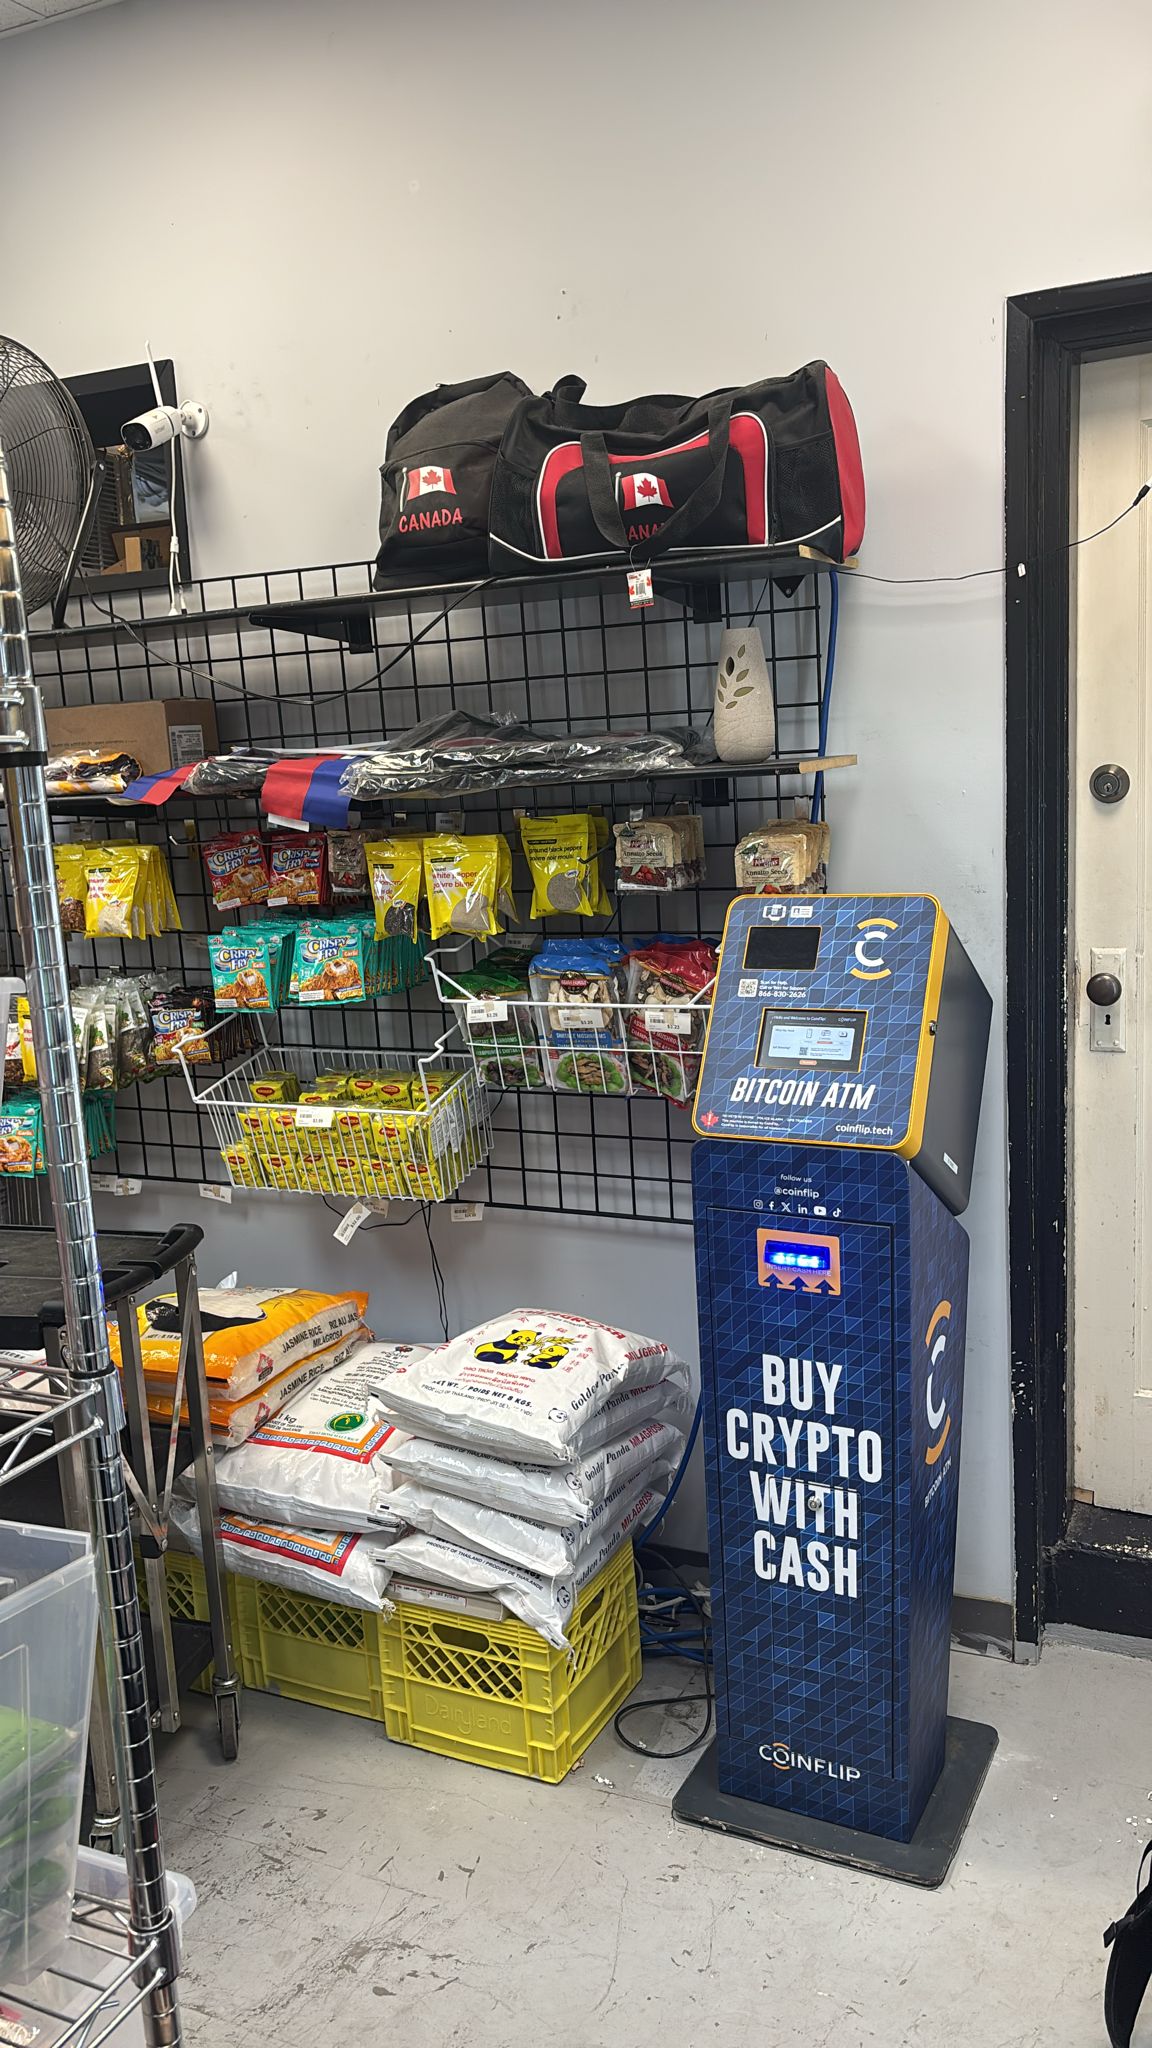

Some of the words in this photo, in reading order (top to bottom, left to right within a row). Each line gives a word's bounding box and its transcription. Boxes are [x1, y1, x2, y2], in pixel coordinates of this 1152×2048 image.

[399, 507, 463, 533] CANADA
[213, 846, 251, 866] CRISPY
[279, 848, 311, 863] CRISPY
[285, 858, 303, 870] FRY
[225, 858, 245, 873] FRY
[308, 936, 347, 952] CRISPY
[319, 946, 339, 961] FRY
[219, 948, 258, 962] CRISPY
[231, 959, 249, 971] FRY
[758, 990, 806, 998] 866-830-2626
[160, 1010, 194, 1024] CRISPY
[170, 1019, 188, 1031] FRY
[730, 1077, 820, 1107] BITCOIN
[820, 1082, 876, 1110] ATM
[835, 1122, 893, 1136] coinflip.tech
[780, 1173, 802, 1182] follow
[774, 1186, 819, 1200] @coinflip
[766, 1264, 790, 1273] INSERT
[812, 1269, 832, 1277] HERE
[282, 1330, 309, 1353] JASMINE
[308, 1325, 323, 1337] RICE
[338, 1316, 347, 1327] AU
[312, 1330, 343, 1349] MILAGROSA
[279, 1372, 308, 1401] JASMINE
[308, 1363, 325, 1381] RICE
[762, 1353, 843, 1415] BUY
[446, 1381, 459, 1389] WT.
[467, 1386, 491, 1396] POIDS
[491, 1391, 507, 1399] NET
[514, 1397, 533, 1408] KGS.
[605, 1391, 631, 1411] Panda
[284, 1414, 297, 1424] kg
[605, 1444, 631, 1465] Panda
[628, 1422, 666, 1449] MILAGROSA
[726, 1408, 882, 1483] CRYPTO
[749, 1470, 858, 1540] WITH
[598, 1529, 621, 1562] Panda
[620, 1490, 654, 1532] MILAGROSA
[426, 1540, 450, 1551] PRODUCT
[458, 1550, 483, 1563] THAILAND
[485, 1560, 508, 1573] PRODUIT
[508, 1568, 515, 1576] DE
[753, 1529, 858, 1598] CASH
[425, 1693, 512, 1735] Dairyland
[759, 1742, 861, 1782] COINFLIP
